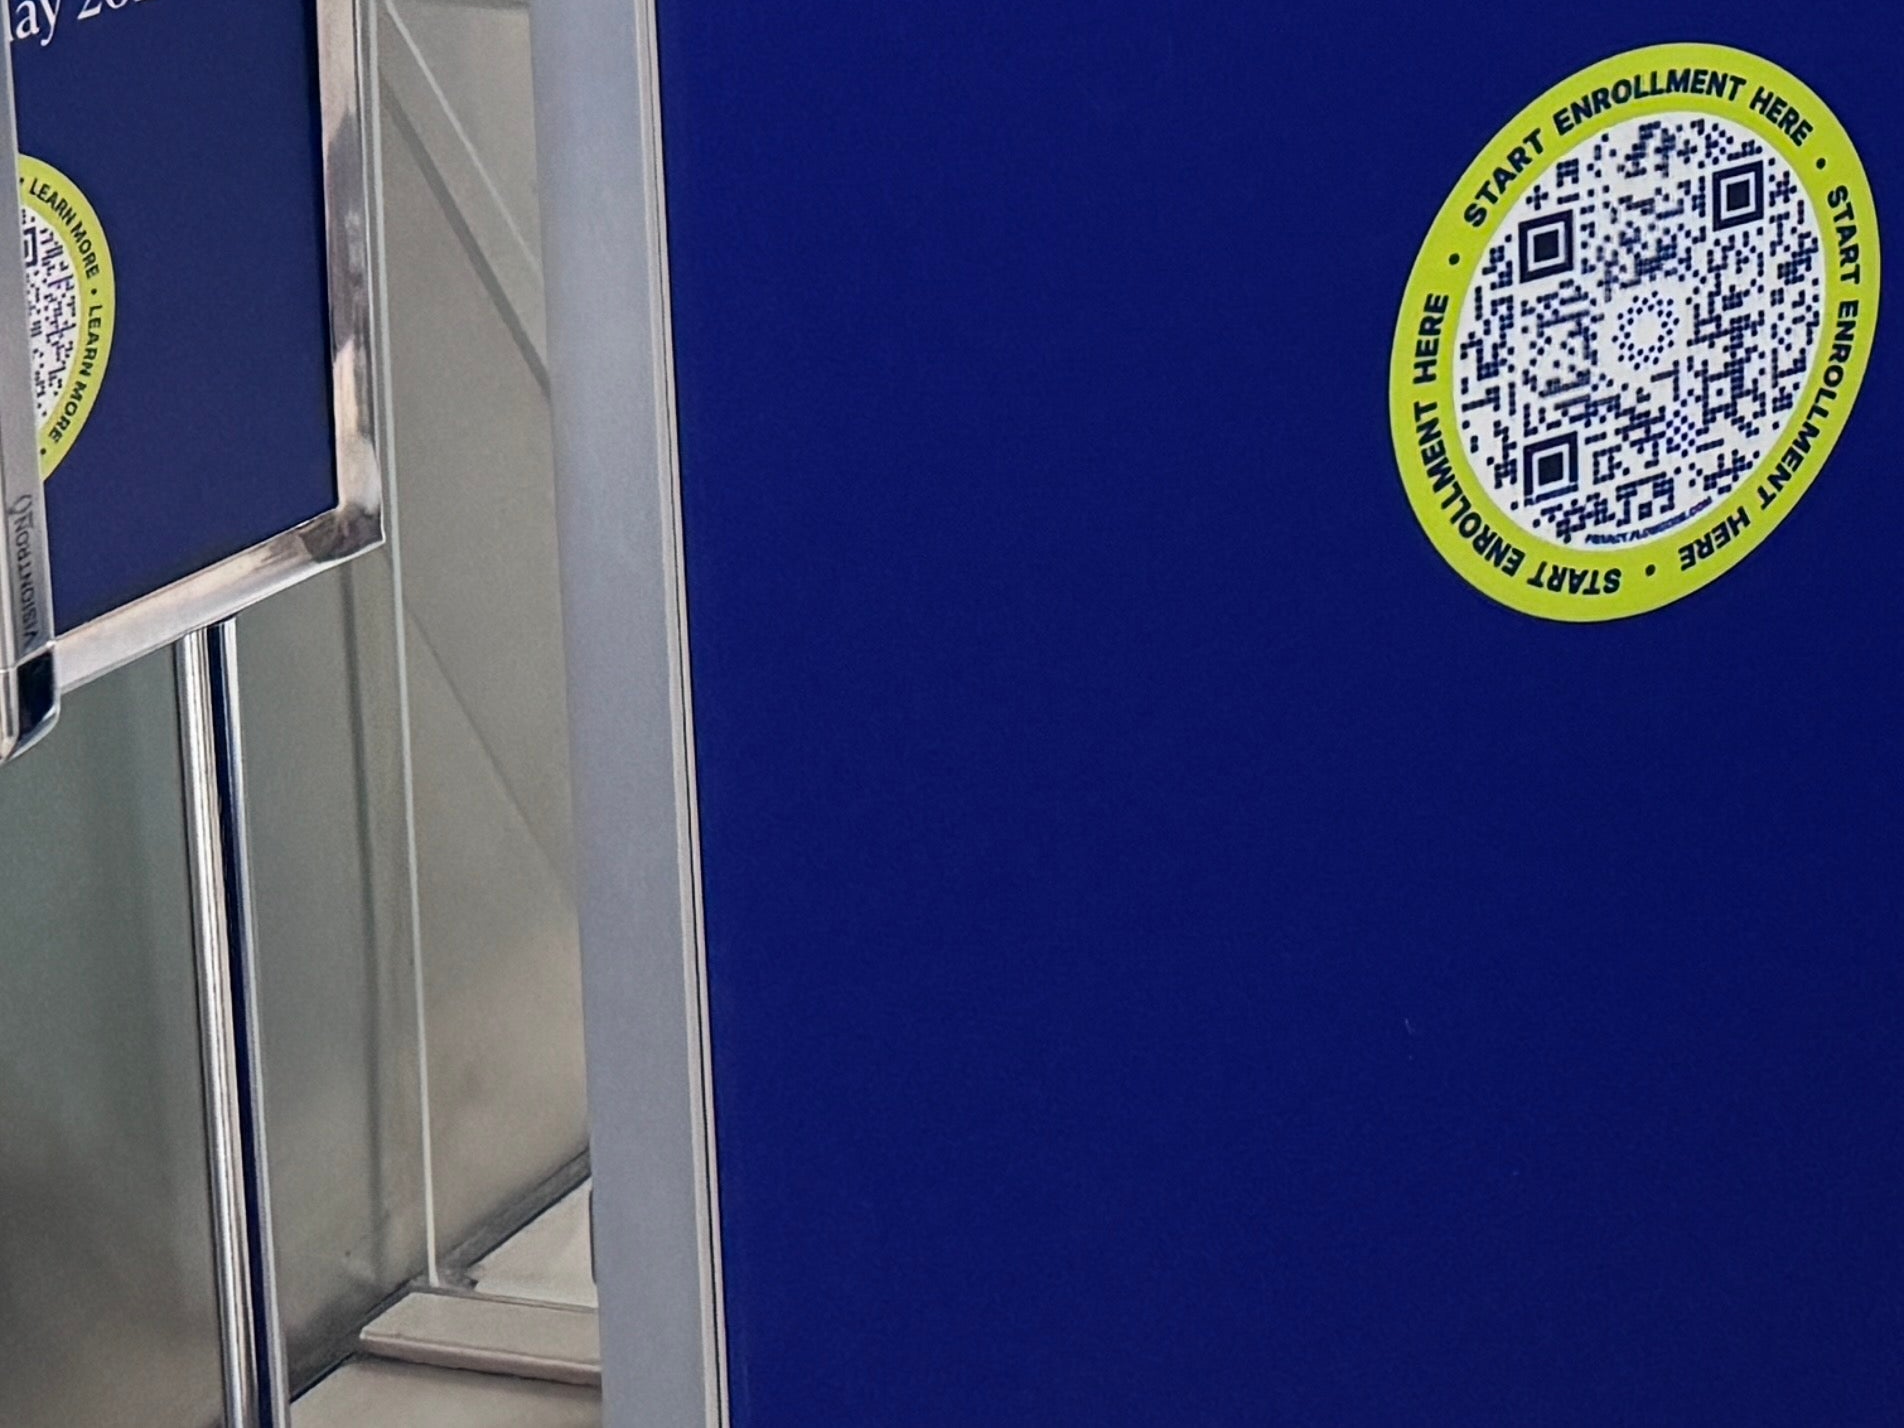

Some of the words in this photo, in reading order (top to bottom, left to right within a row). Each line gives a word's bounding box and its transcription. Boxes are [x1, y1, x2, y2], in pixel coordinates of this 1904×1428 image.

[1463, 127, 1546, 228] START
[1553, 69, 1747, 136] ENROLLMENT
[1750, 86, 1815, 147] HERE
[29, 177, 76, 227] LEARN
[71, 222, 100, 279] MORE
[1827, 185, 1860, 284] START
[82, 305, 103, 377] LEARN
[1413, 293, 1449, 385] HERE
[48, 383, 86, 443] MORE
[1754, 299, 1859, 510] ENROLLMENT
[1413, 400, 1526, 576] ENROLLMENT
[1528, 560, 1622, 596] START
[1678, 506, 1751, 571] HERE
